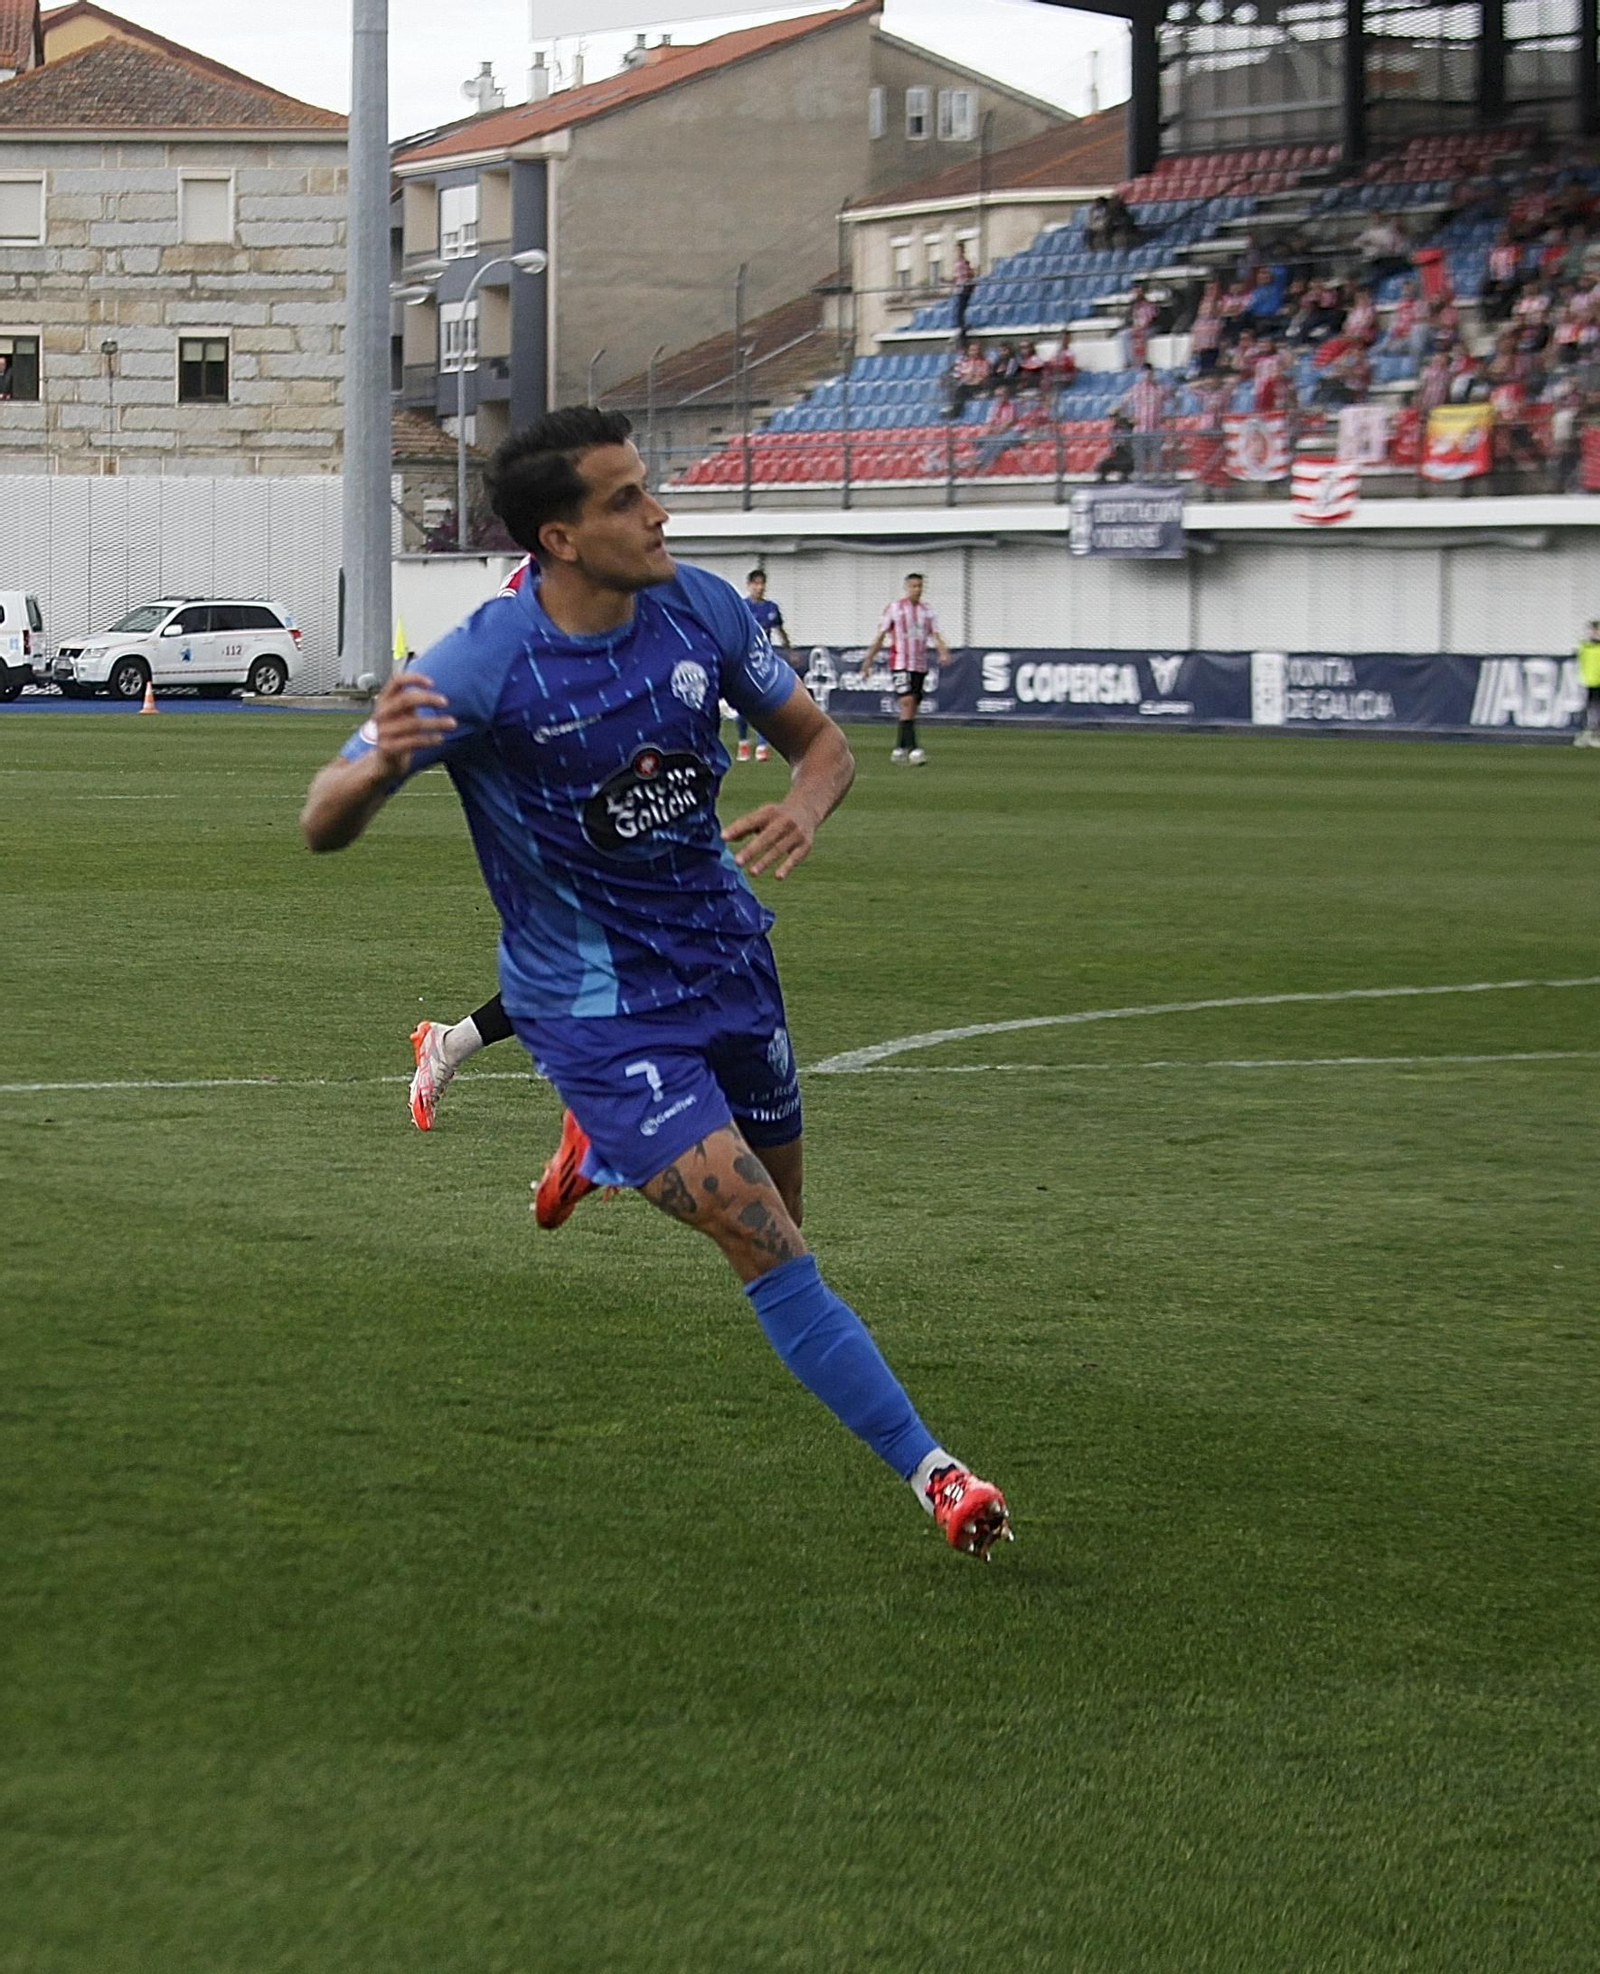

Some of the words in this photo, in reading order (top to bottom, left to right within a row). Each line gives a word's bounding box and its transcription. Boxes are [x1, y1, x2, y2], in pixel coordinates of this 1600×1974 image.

[225, 645, 242, 656] 112
[1015, 662, 1143, 704] COPERSA
[624, 1060, 664, 1103] 7
